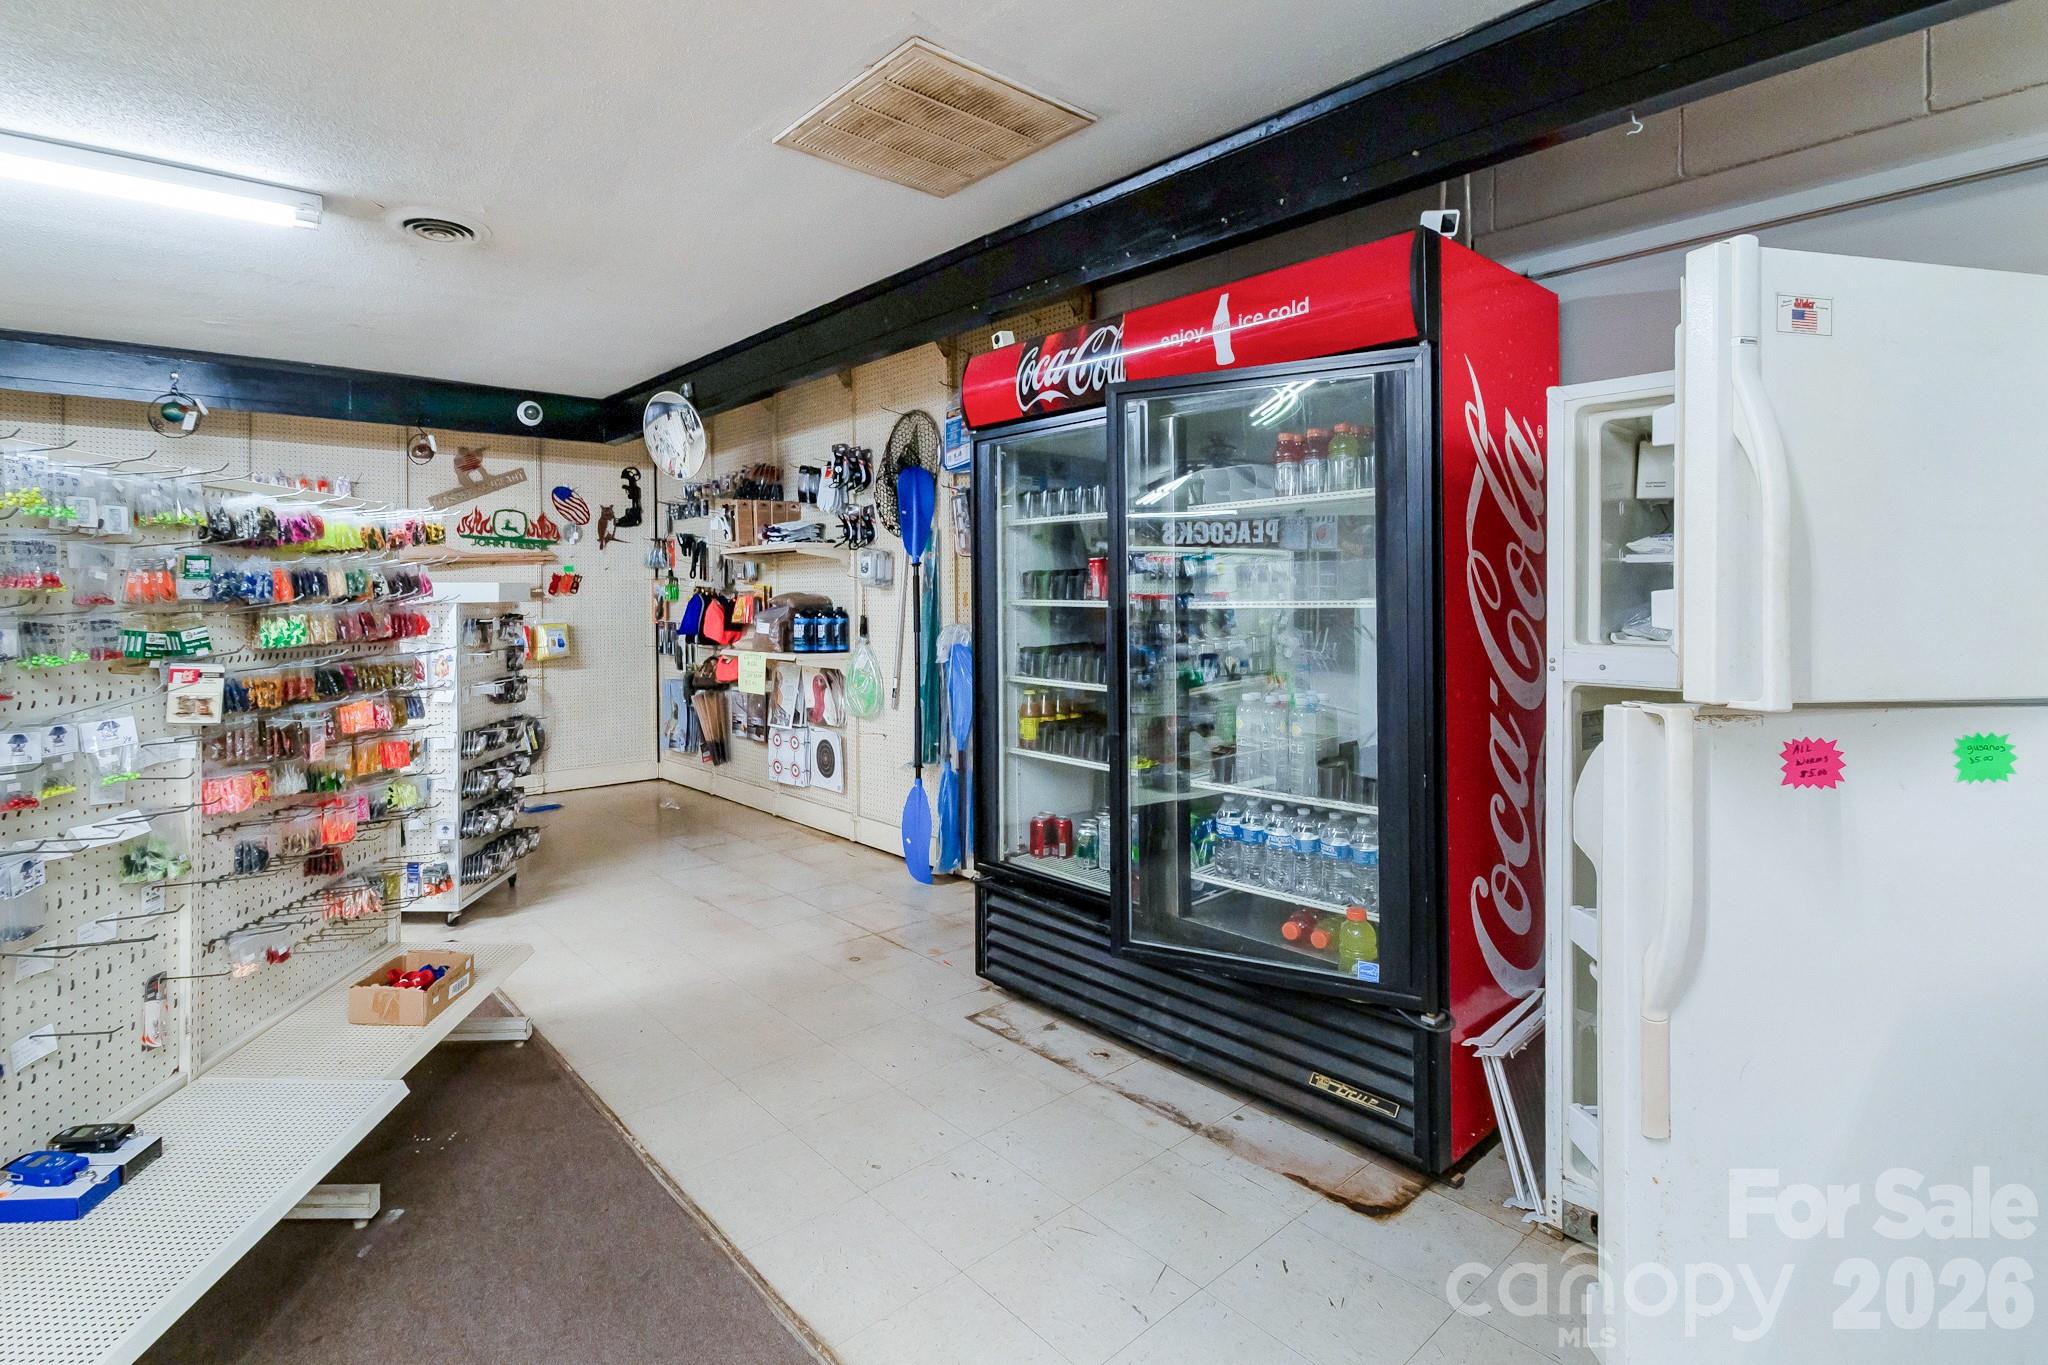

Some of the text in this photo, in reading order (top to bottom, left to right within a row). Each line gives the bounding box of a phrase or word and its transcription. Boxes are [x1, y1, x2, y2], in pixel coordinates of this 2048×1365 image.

[1161, 327, 1204, 347] enjoy
[1238, 313, 1264, 327] ice
[1268, 296, 1310, 319] cold
[1792, 744, 1812, 755] ALL
[1967, 744, 2006, 755] gusanos
